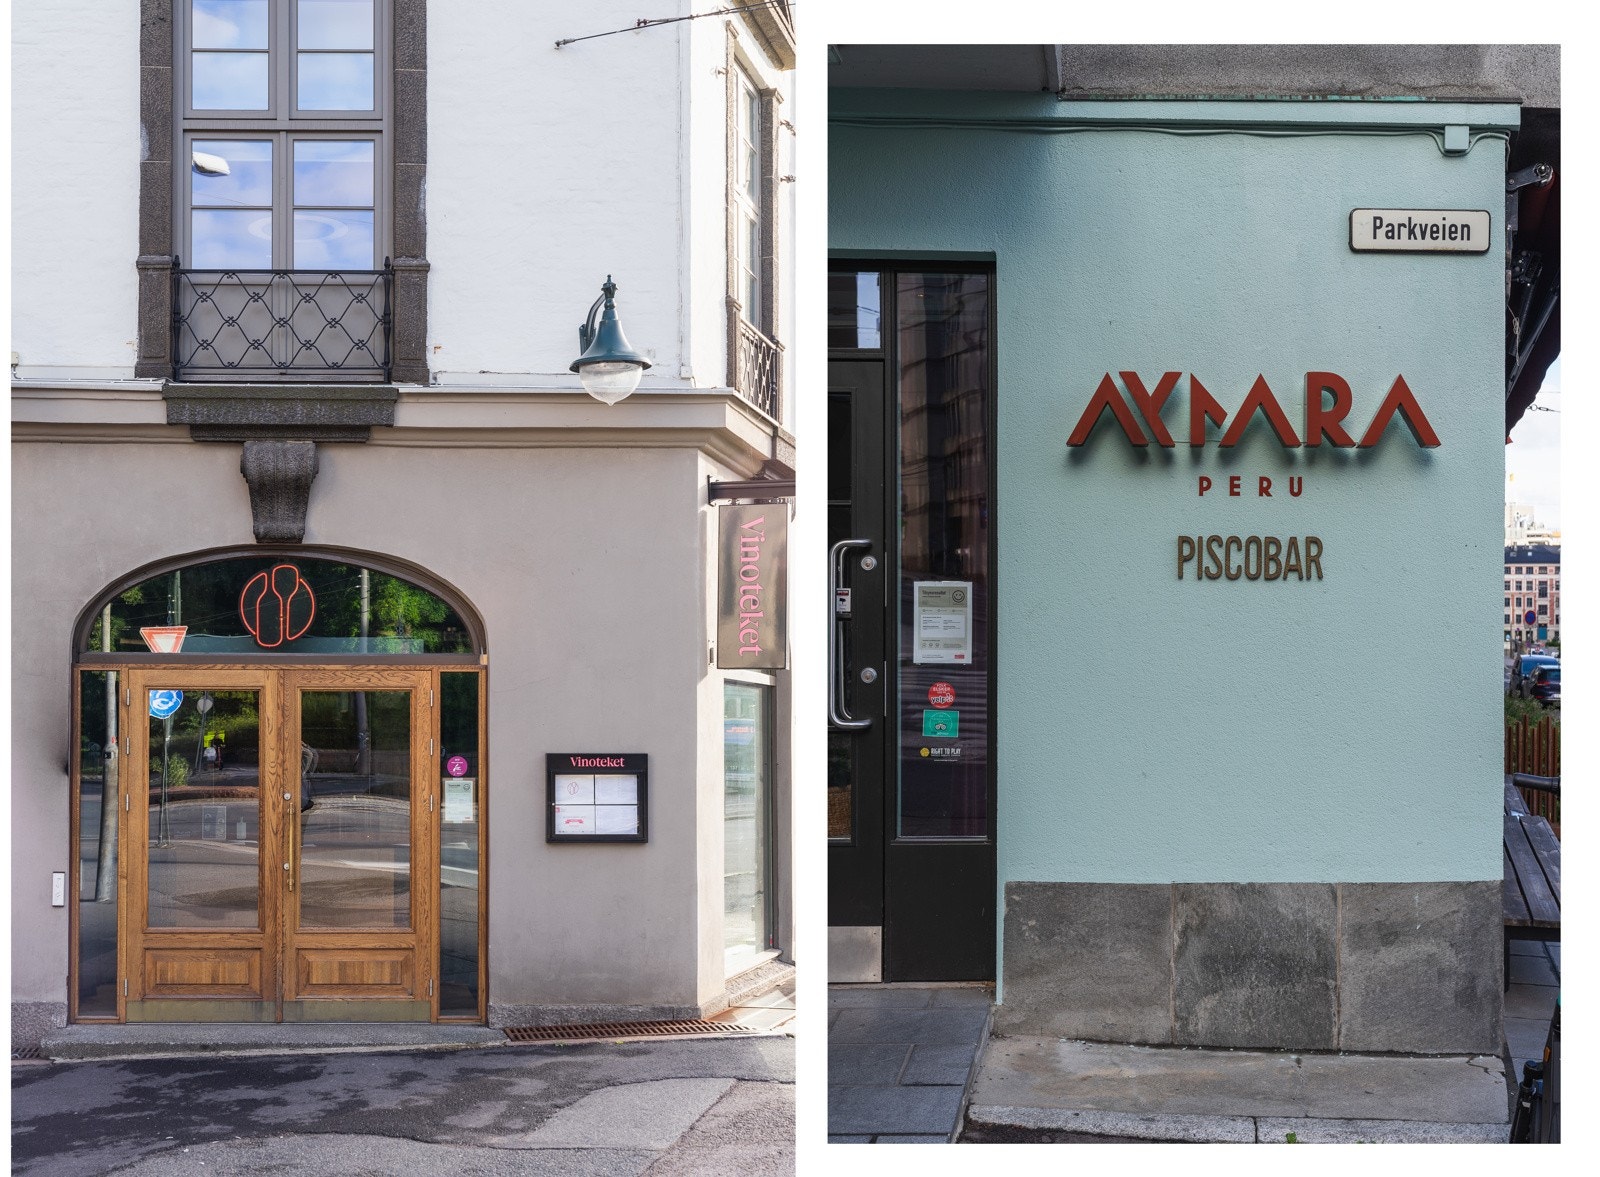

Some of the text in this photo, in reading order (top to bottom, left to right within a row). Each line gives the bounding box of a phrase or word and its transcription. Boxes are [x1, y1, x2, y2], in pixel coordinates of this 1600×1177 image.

[1372, 216, 1471, 241] Parkveien
[1066, 371, 1442, 448] AYMARA
[1198, 475, 1303, 498] PERU
[1177, 535, 1323, 581] PISCOBAR
[738, 515, 765, 657] Vinoteket
[570, 756, 625, 767] Vinoteket
[930, 747, 961, 755] RIGHT TO PLAY
